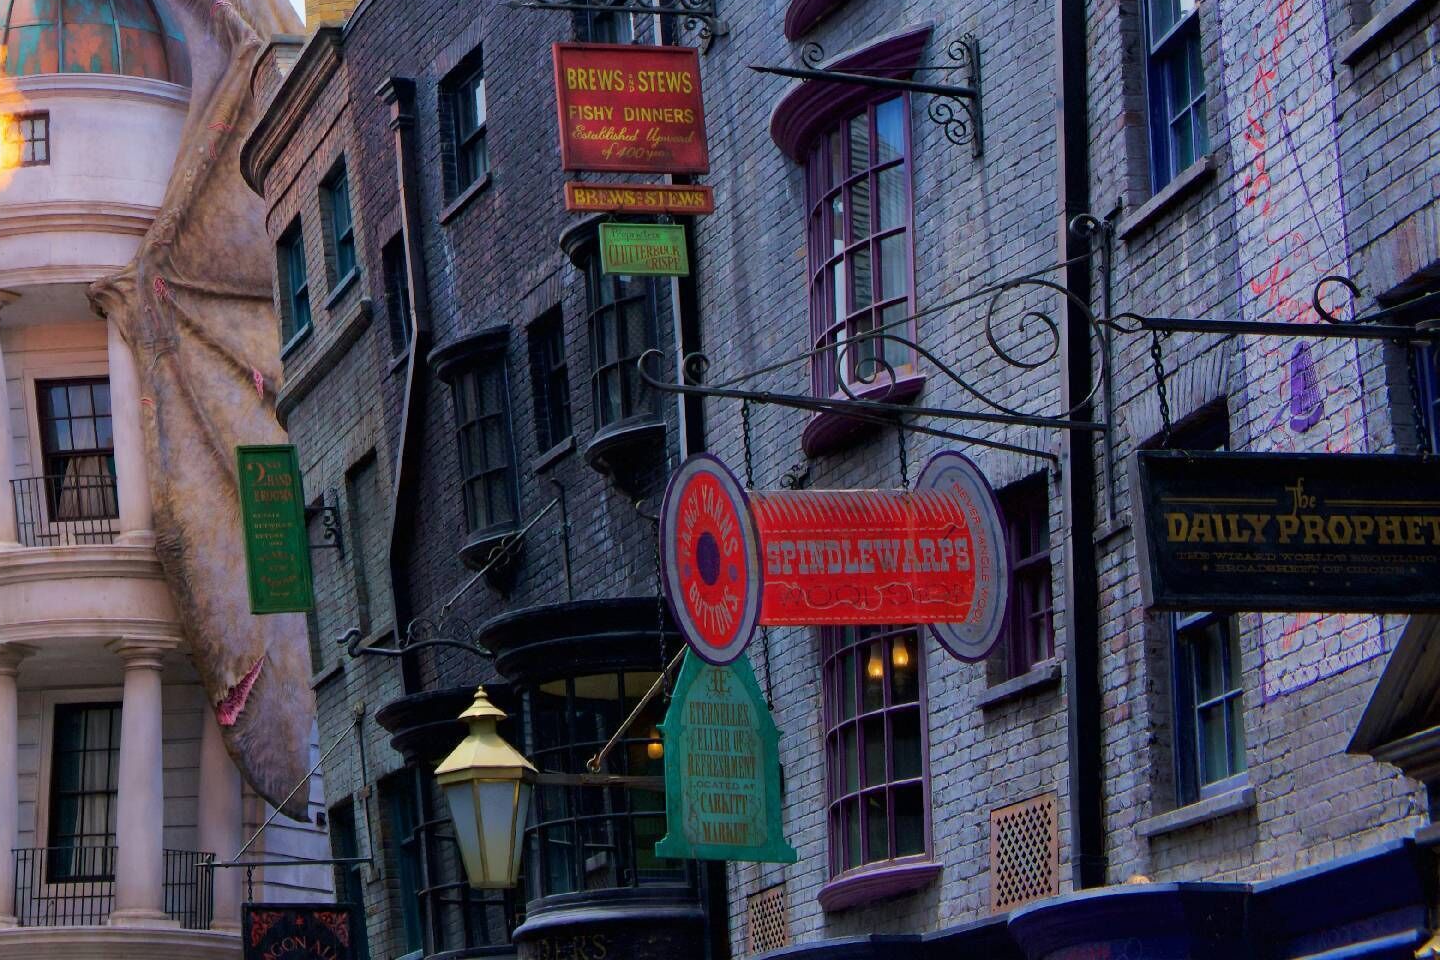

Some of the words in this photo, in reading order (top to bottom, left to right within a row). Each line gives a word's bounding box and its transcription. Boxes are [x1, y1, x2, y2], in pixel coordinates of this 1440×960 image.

[566, 67, 625, 92] BREWS
[637, 71, 693, 94] STEWS
[569, 105, 614, 121] FISHY
[624, 107, 695, 125] DINNERS
[572, 125, 640, 142] Established
[574, 189, 636, 206] BREWS
[645, 190, 705, 208] STEWS
[701, 484, 739, 558] YARNS
[1164, 512, 1272, 542] DAILY
[1276, 515, 1440, 545] PROPHET
[766, 537, 971, 575] SPINDLEWARPS
[689, 580, 739, 636] BUTTONS
[697, 730, 730, 751] ELIXIR
[688, 753, 756, 780] REFRESHMENT
[700, 792, 748, 816] CARKITT
